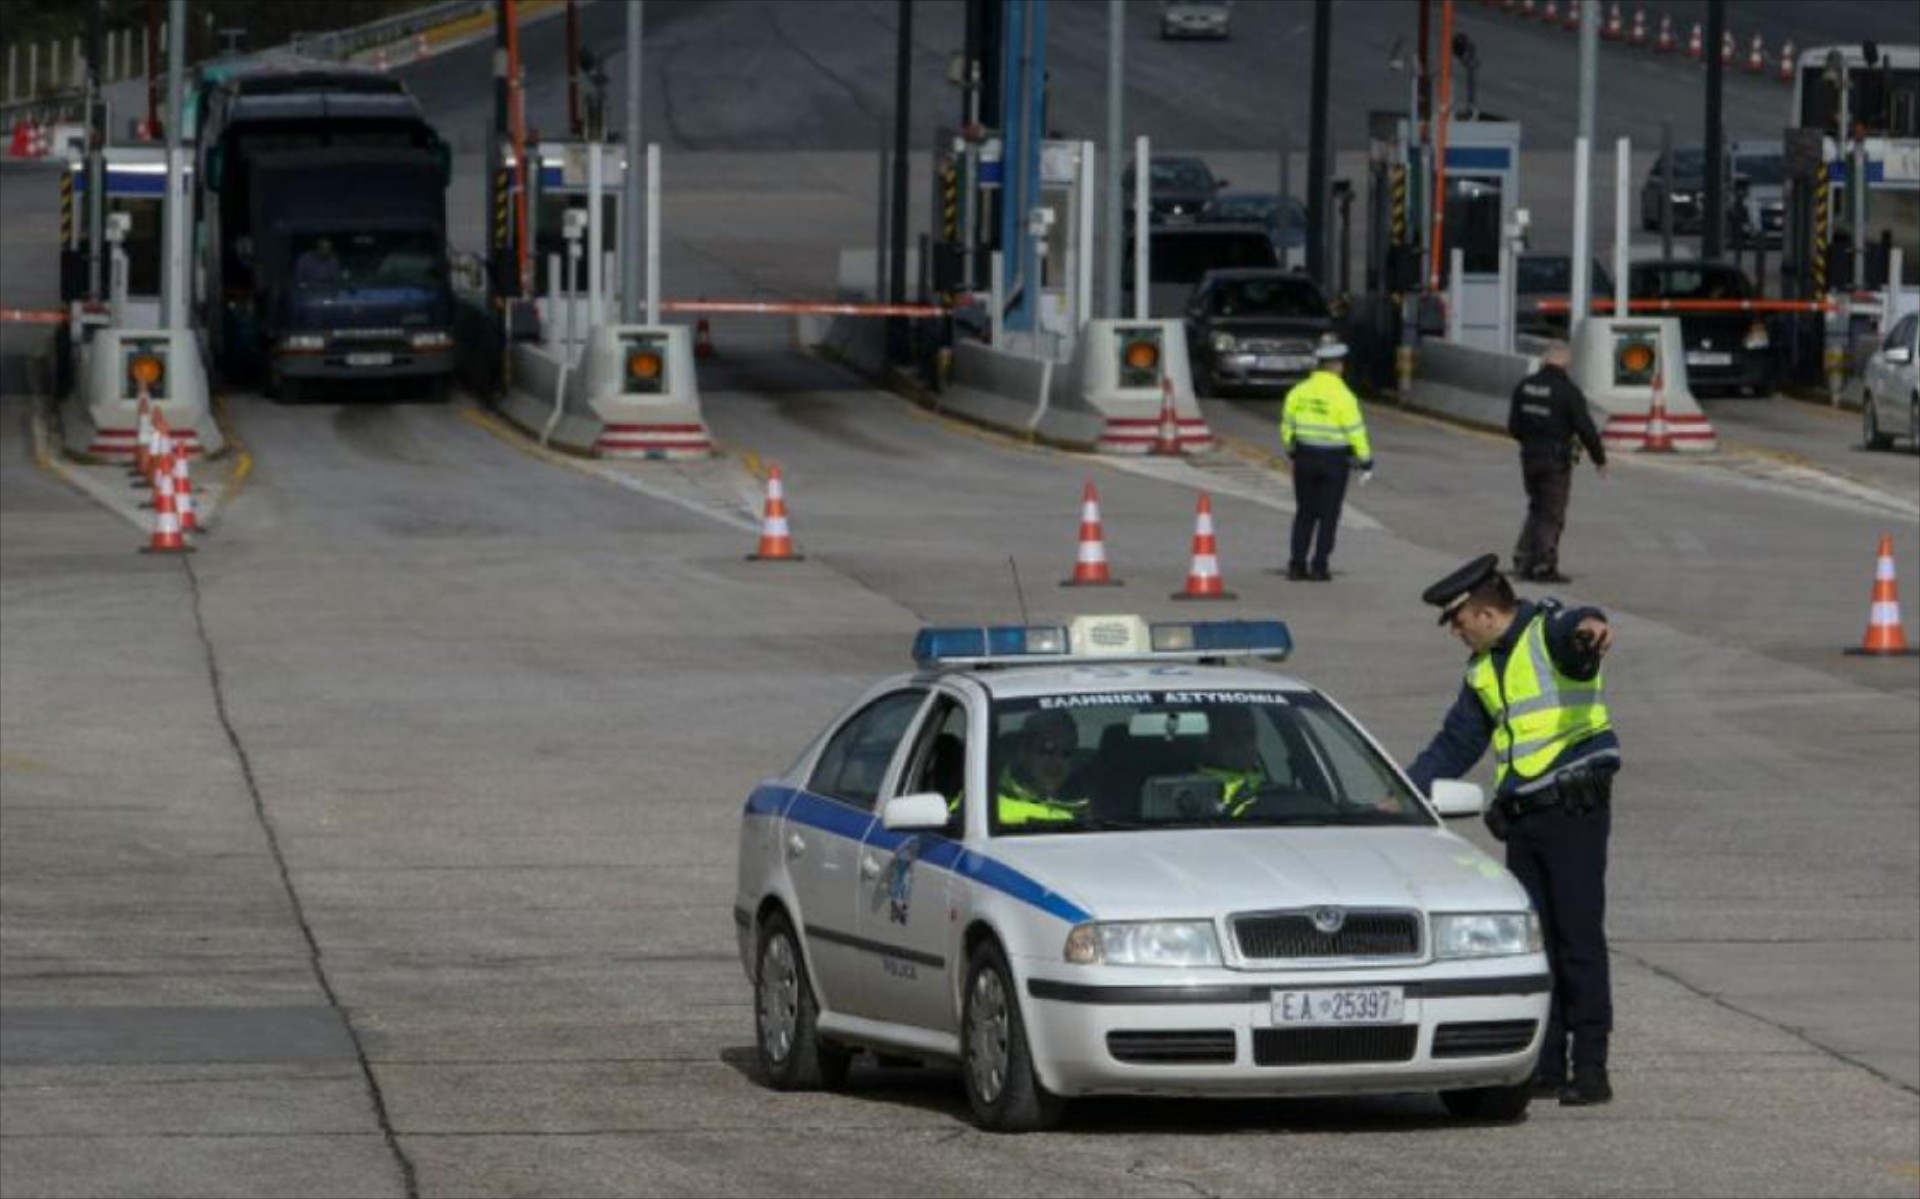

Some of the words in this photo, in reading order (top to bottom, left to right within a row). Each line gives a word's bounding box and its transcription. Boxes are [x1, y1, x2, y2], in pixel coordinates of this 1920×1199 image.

[1039, 693, 1152, 709] ΕΛΛΗΝΙΚΗ
[1165, 691, 1289, 705] ΑΣΤΥΝΟΜΙΑ
[1332, 991, 1391, 1020] 25397
